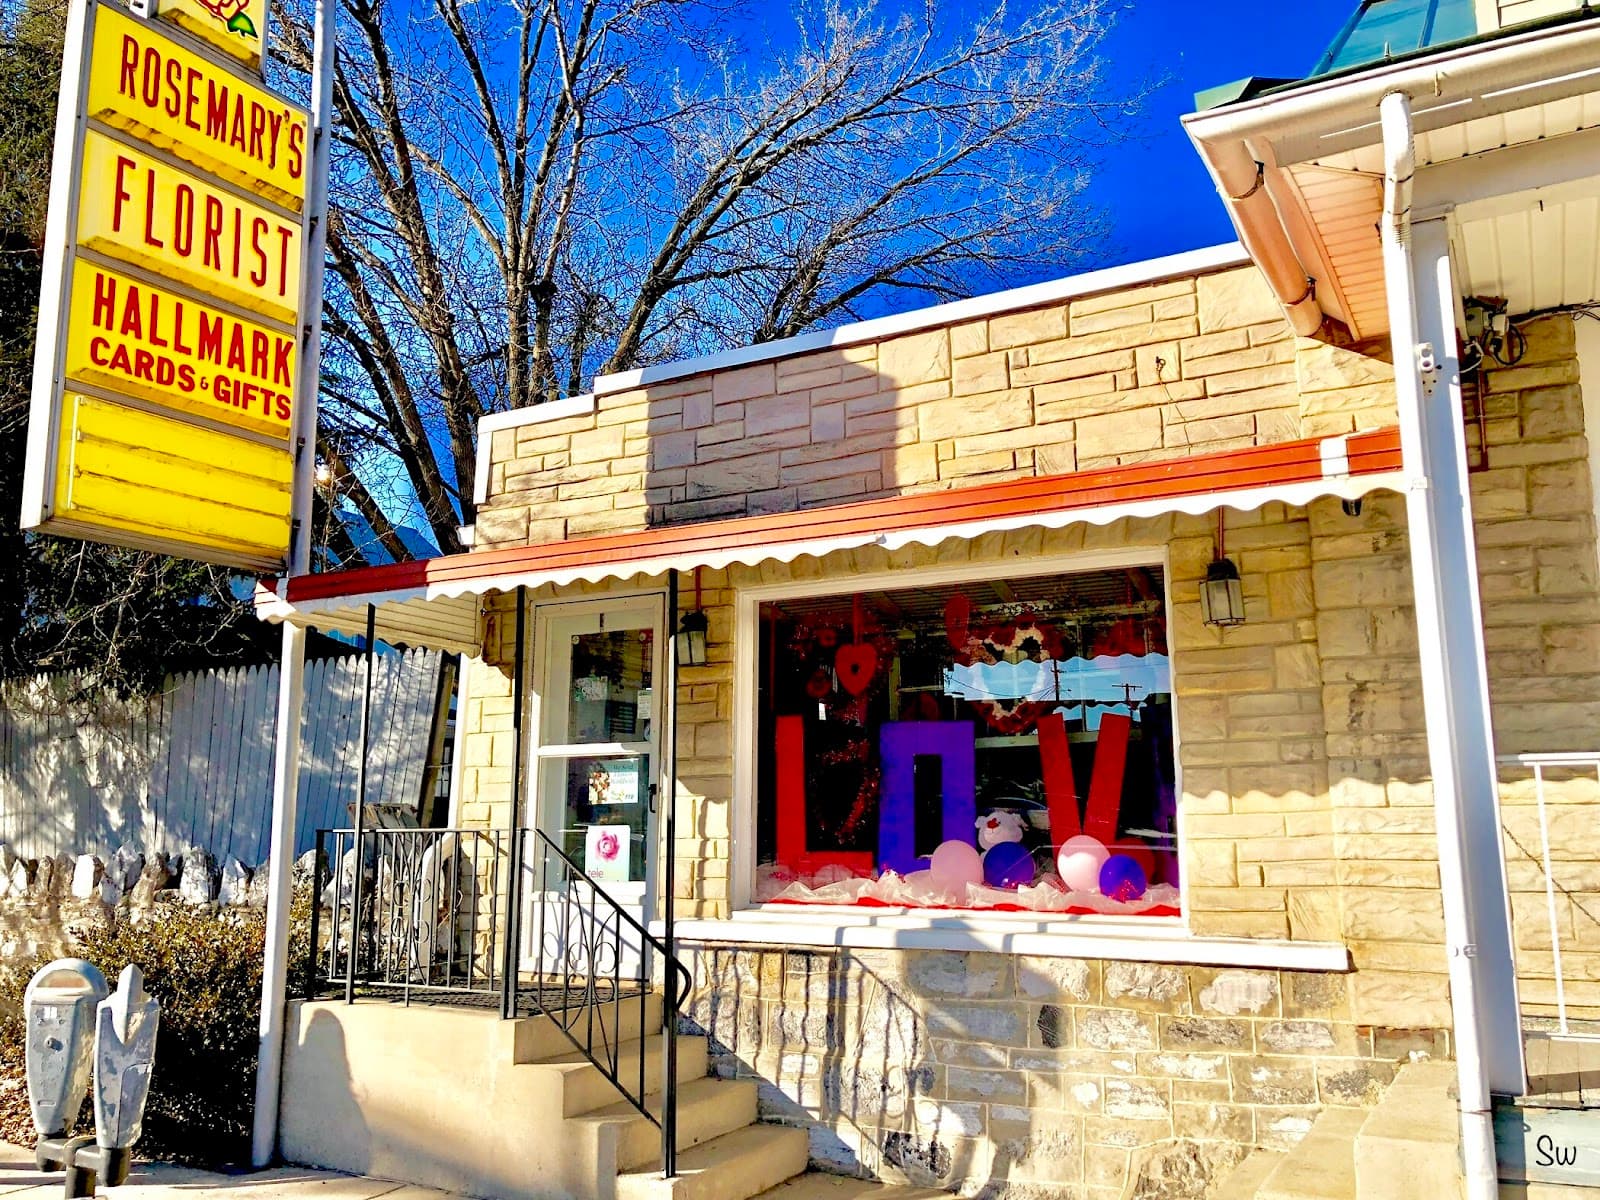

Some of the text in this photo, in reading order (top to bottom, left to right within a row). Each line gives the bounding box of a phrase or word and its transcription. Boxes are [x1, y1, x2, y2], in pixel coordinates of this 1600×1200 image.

[119, 34, 304, 179] ROSEMARY'S
[114, 155, 294, 297] FLORIST
[90, 336, 196, 393] CARDS
[213, 374, 292, 421] GIFTS
[92, 272, 294, 388] HALLMARK
[775, 711, 1178, 888] LOV
